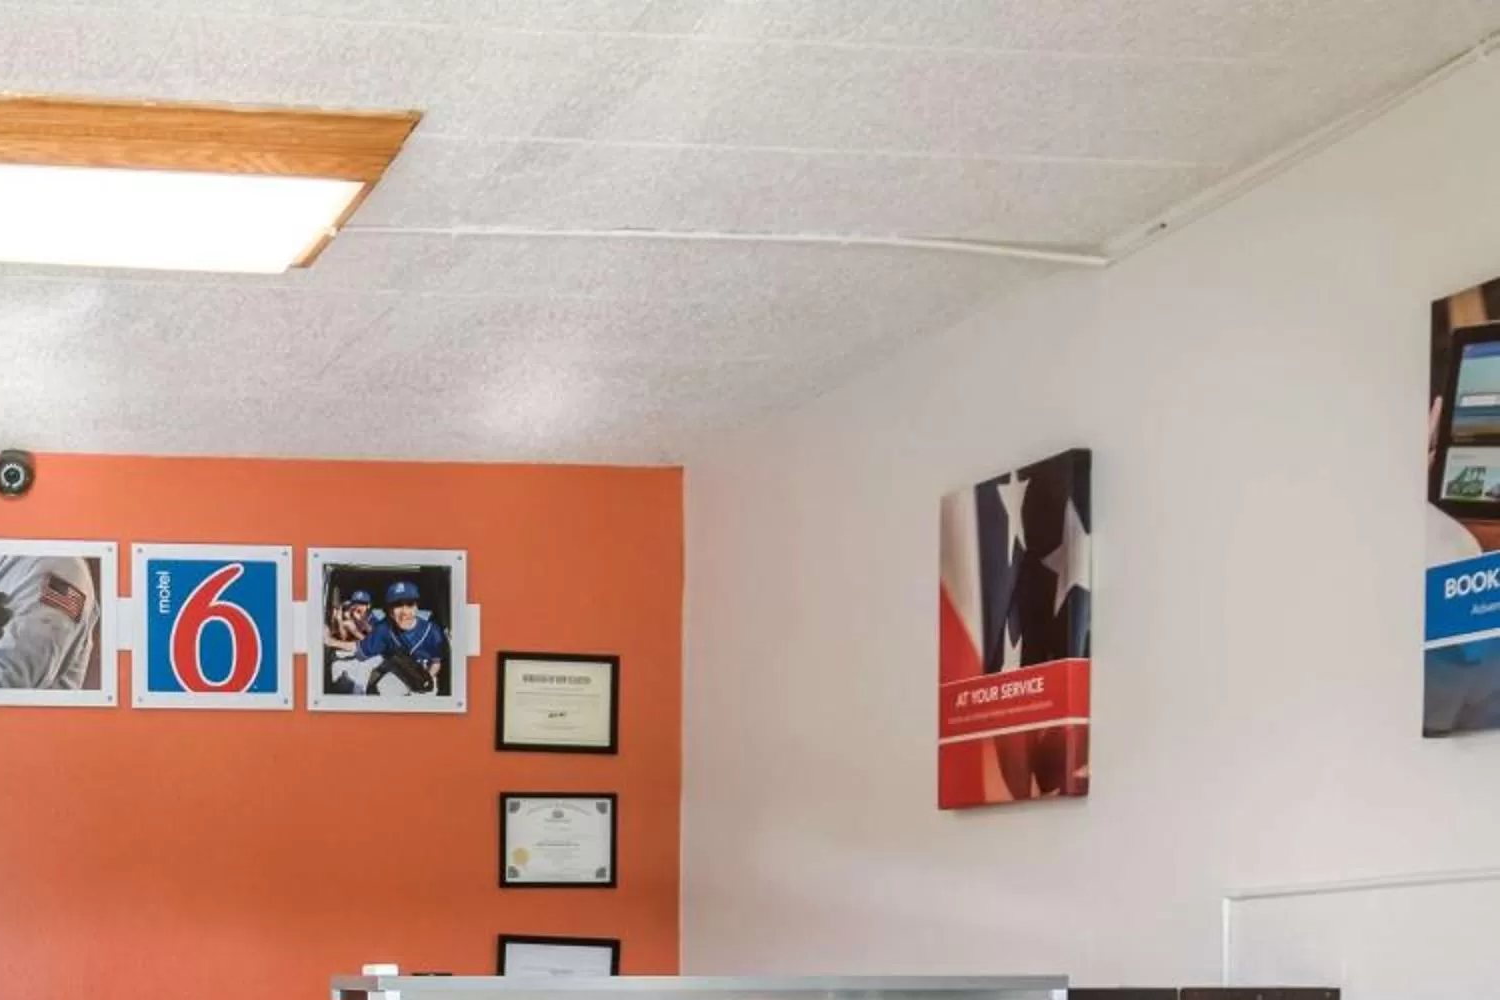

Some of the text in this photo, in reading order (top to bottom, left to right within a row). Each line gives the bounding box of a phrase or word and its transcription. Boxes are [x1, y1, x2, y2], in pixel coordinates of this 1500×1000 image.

[156, 563, 262, 693] motel 6
[956, 677, 1045, 707] AT YOUR SERVICE
